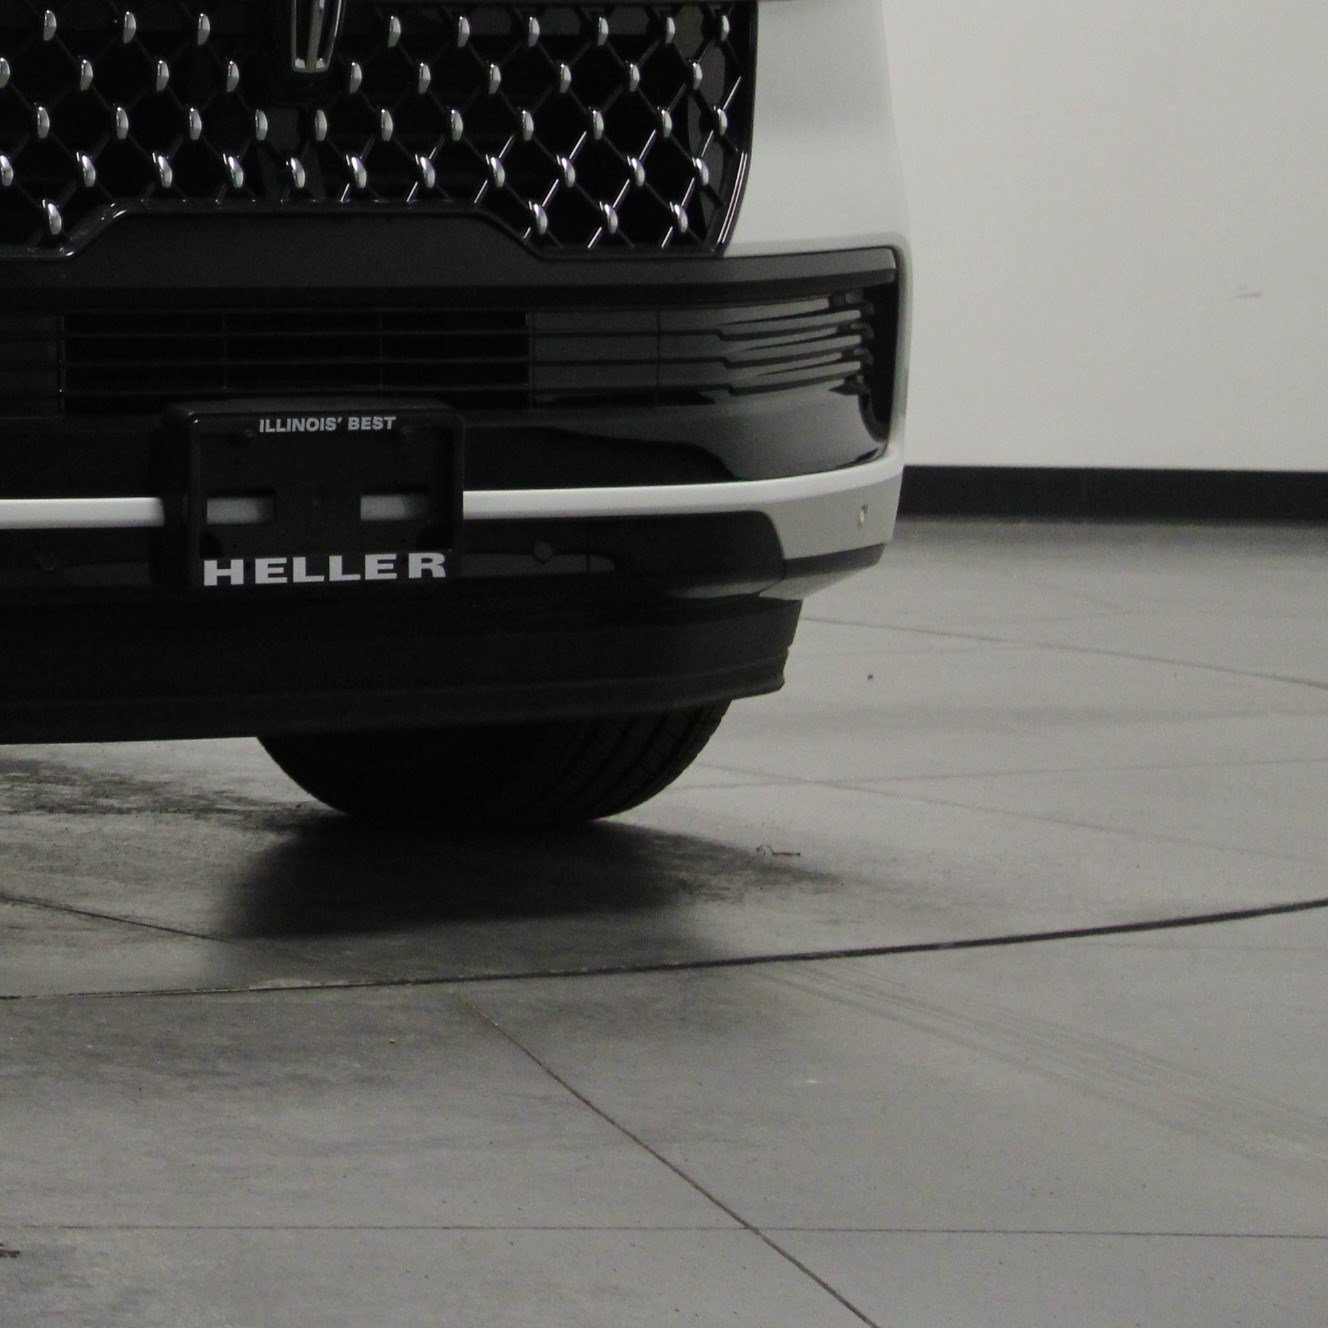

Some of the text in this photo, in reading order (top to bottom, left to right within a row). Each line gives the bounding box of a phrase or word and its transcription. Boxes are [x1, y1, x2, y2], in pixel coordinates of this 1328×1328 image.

[259, 416, 397, 433] ILLINOIS' BEST
[203, 552, 447, 586] HELLER
